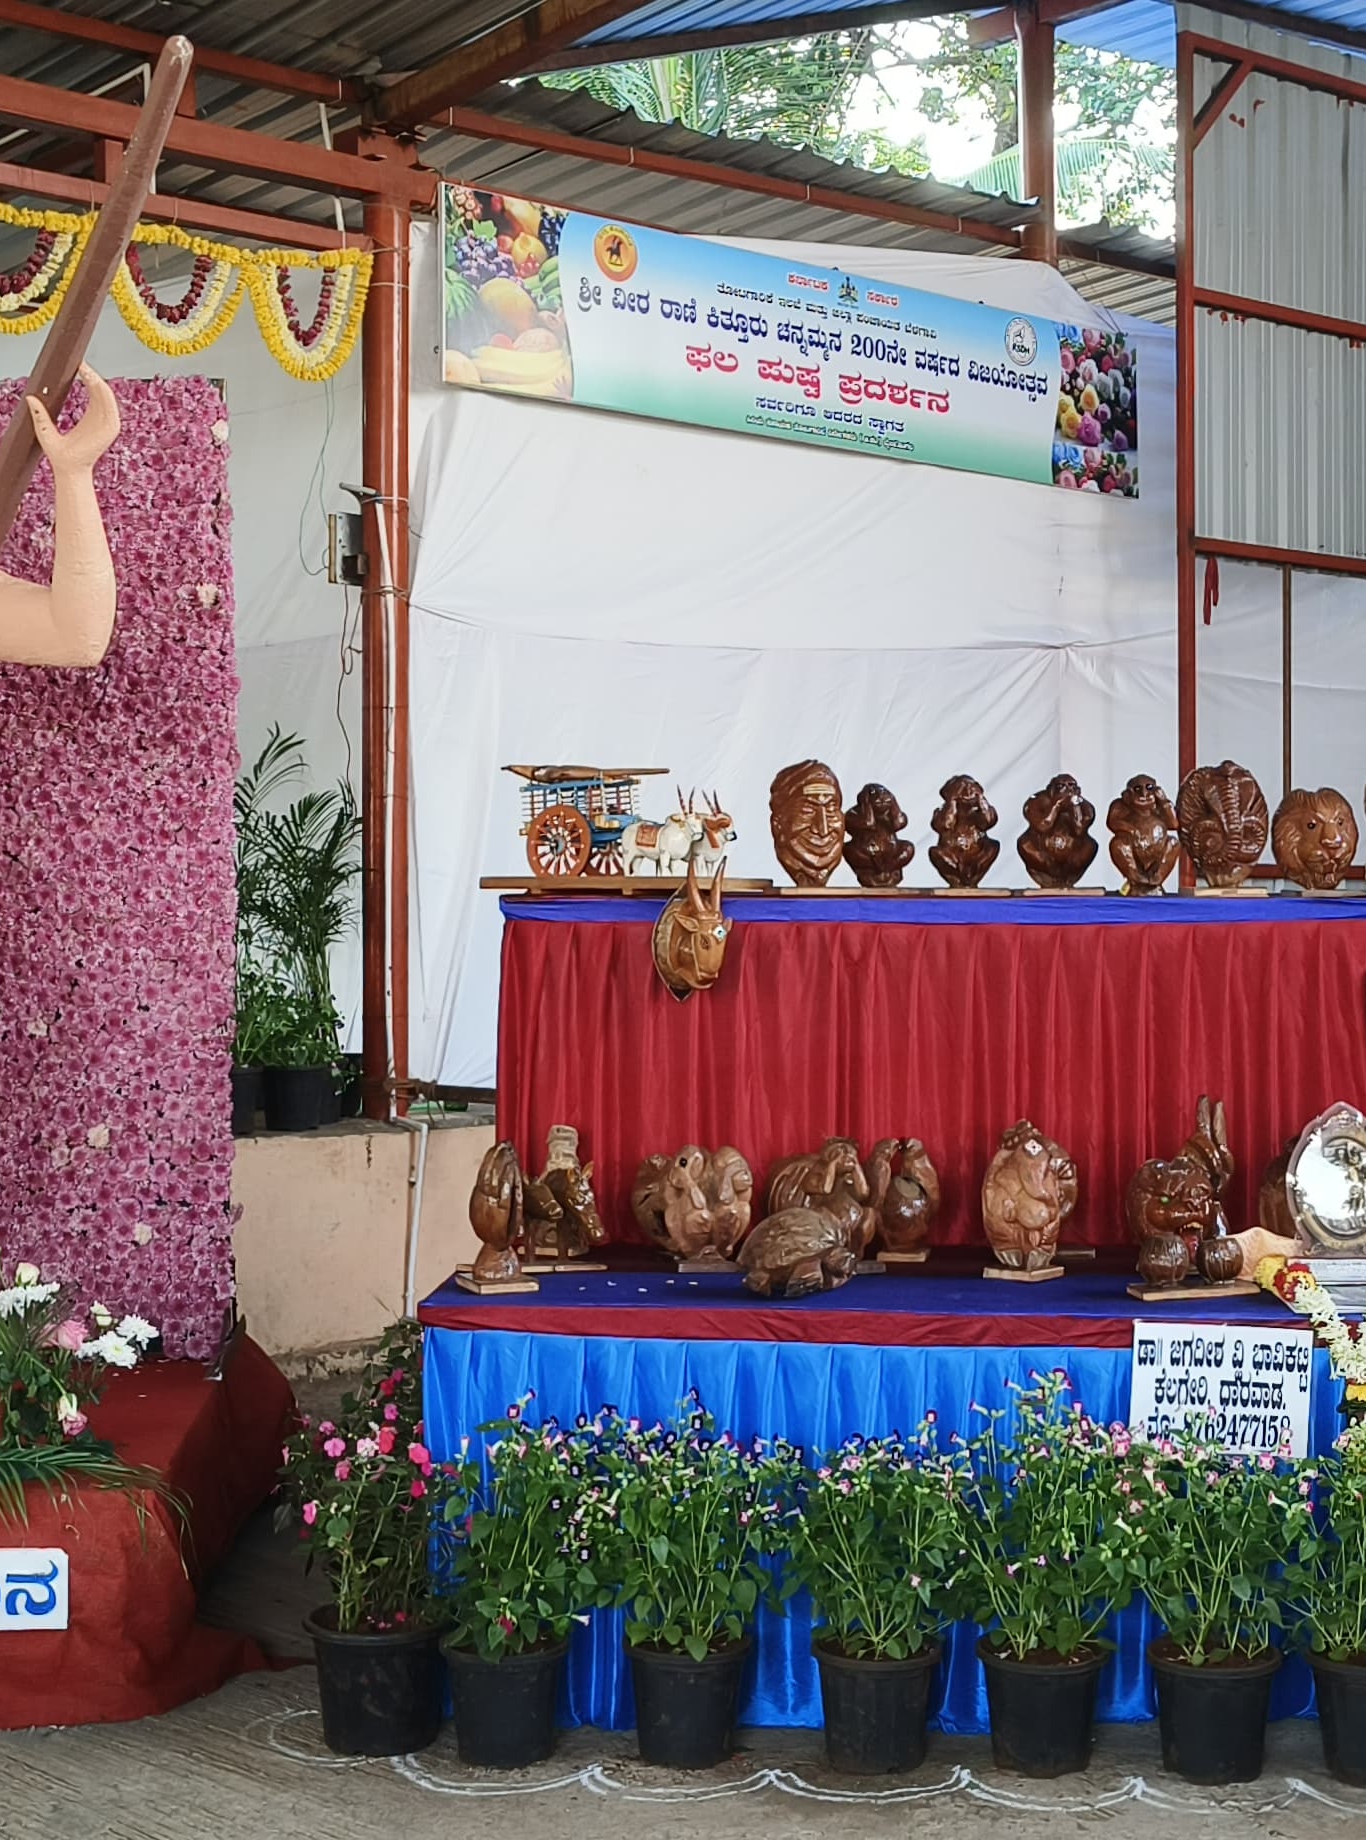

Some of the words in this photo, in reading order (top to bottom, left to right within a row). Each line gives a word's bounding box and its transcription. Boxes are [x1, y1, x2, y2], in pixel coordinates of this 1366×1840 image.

[577, 276, 602, 313] ಶ್ರೀ
[611, 286, 651, 315] ವೀರ
[659, 296, 698, 324] ರಾಣಿ
[706, 304, 769, 343] ಕಿತ್ತೂರು
[776, 317, 842, 362] ಚನ್ನಮ್ಮನ
[850, 333, 907, 368] 200ನೇ
[914, 346, 960, 378] ವರ್ಷದ
[967, 360, 1048, 402] ವಿಜಯೋತ್ಸವ
[685, 342, 739, 375] ಫಲ
[756, 356, 822, 400] ಪುಷ್ಪ
[837, 371, 951, 415] ಪ್ರದರ್ಶನ
[1170, 1331, 1225, 1368] ಜಗದೀಶ
[1252, 1336, 1309, 1393] ಭಾವಿಕಟ್ಟಿ
